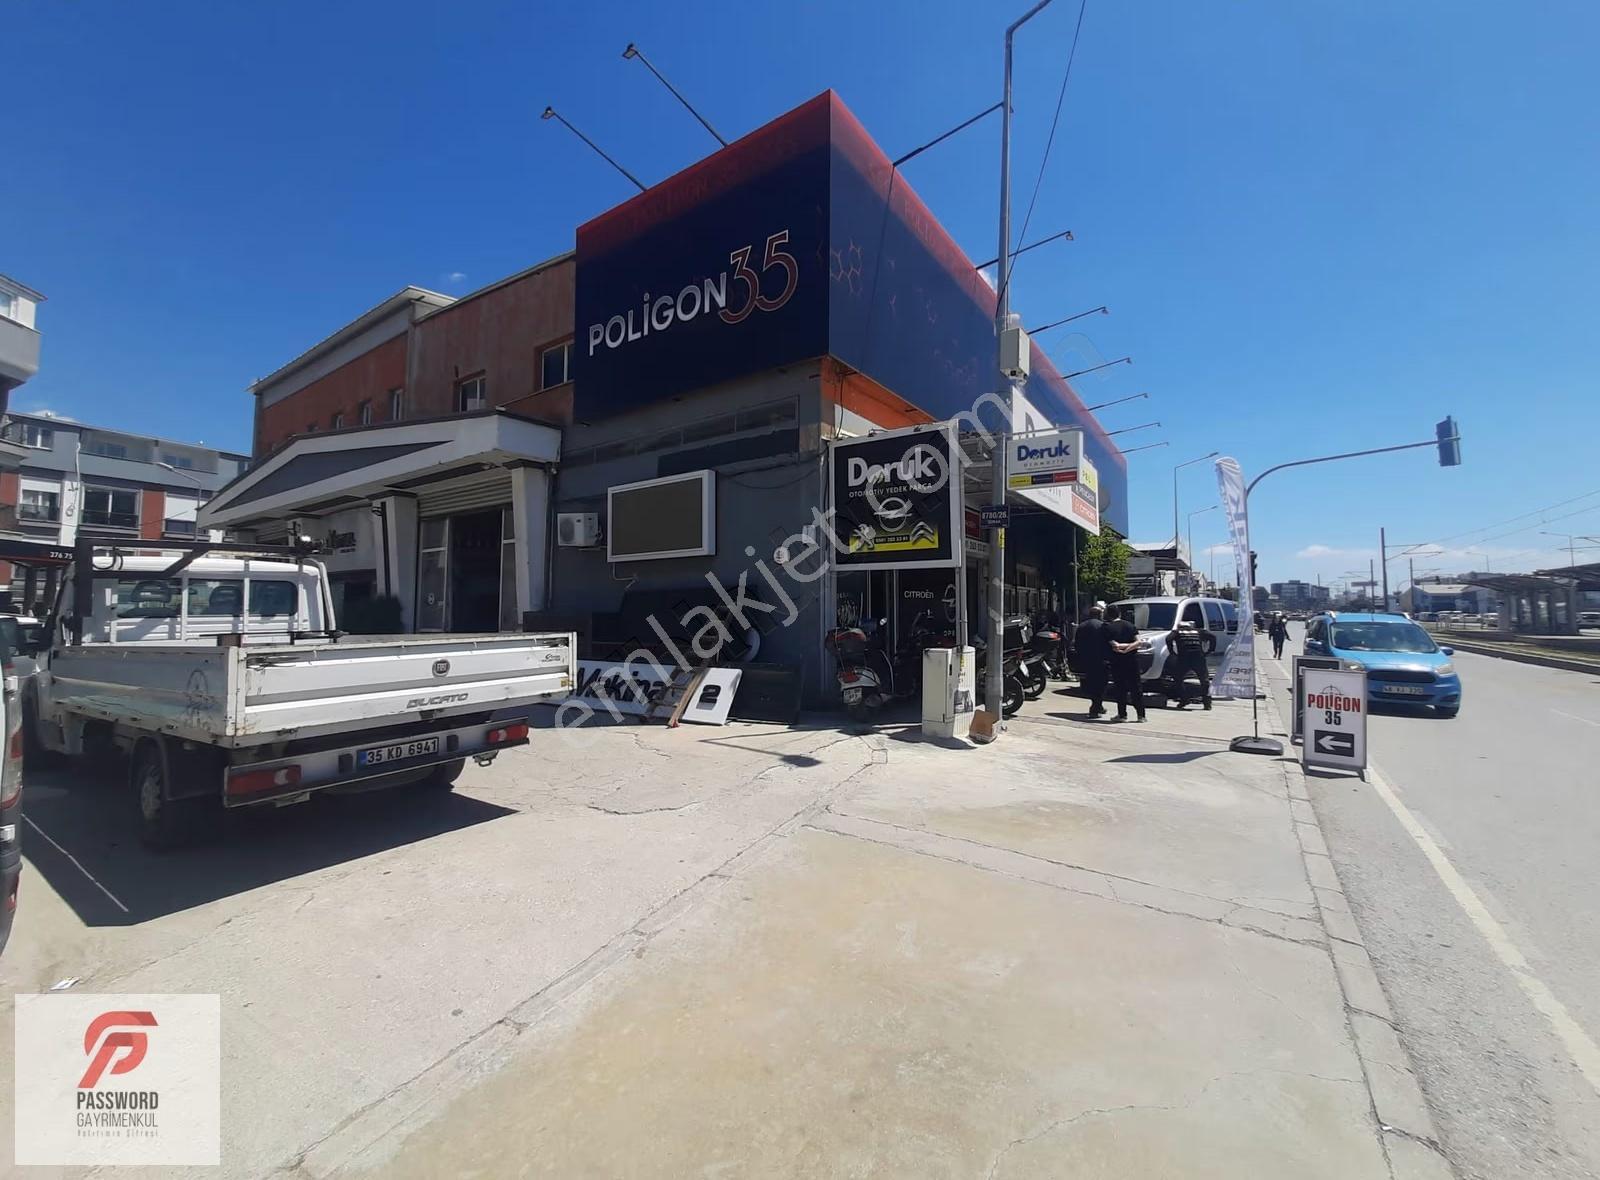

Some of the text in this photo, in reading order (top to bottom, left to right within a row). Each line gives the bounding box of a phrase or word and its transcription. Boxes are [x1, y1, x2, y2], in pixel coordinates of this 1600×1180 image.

[1017, 440, 1071, 461] Doruk
[847, 447, 936, 487] Doruk
[886, 485, 907, 494] YEDEK
[406, 692, 469, 709] DUCATO
[1308, 693, 1361, 713] POLİGON
[1324, 710, 1342, 726] 35
[367, 738, 438, 763] 35 KD 6941
